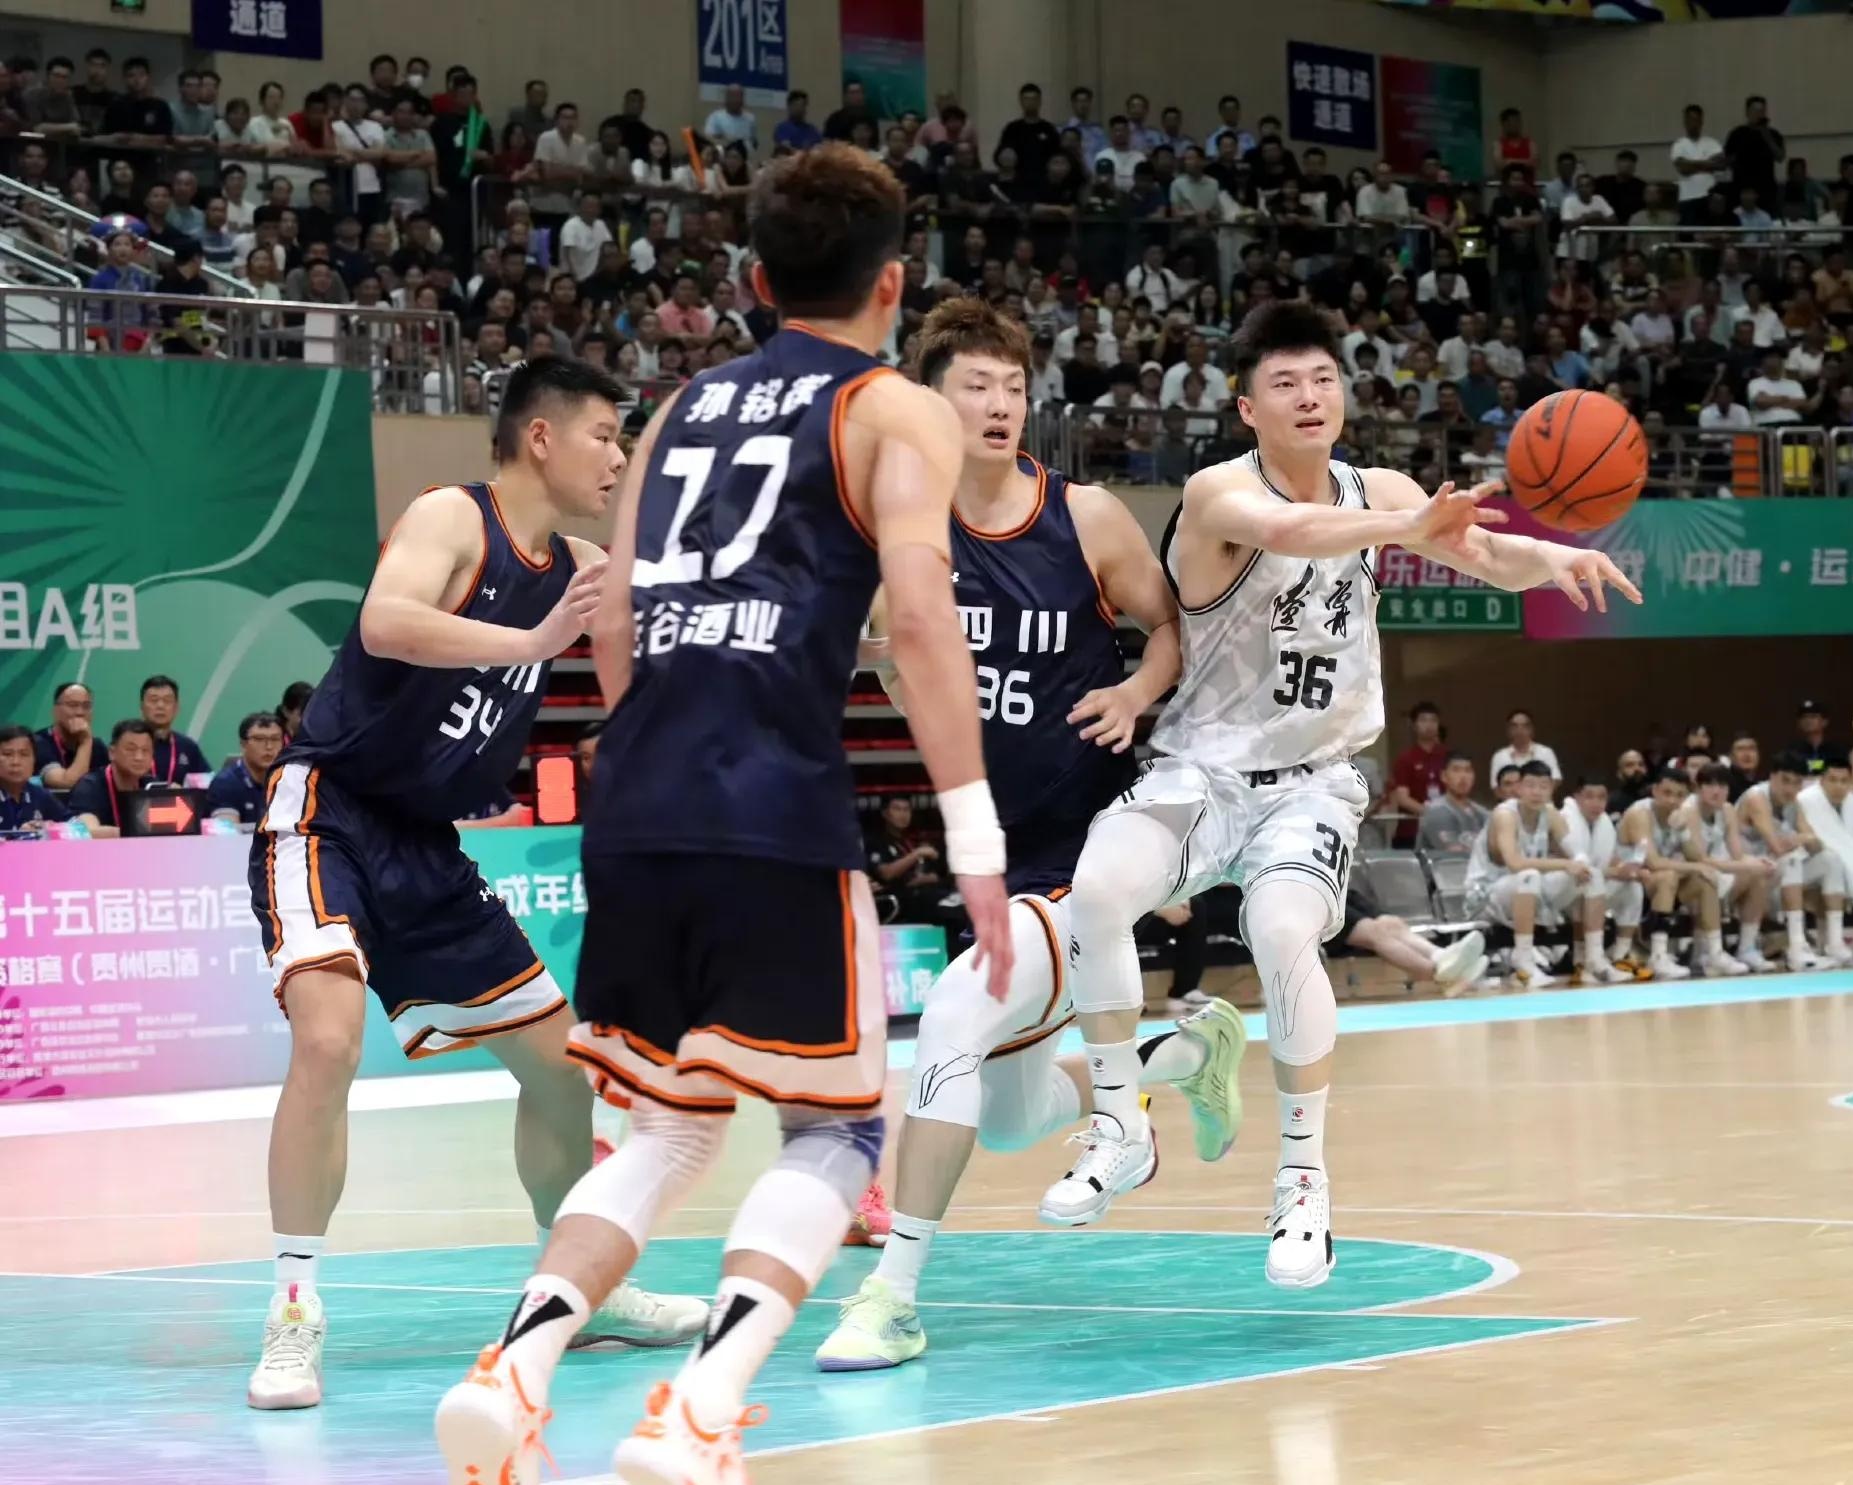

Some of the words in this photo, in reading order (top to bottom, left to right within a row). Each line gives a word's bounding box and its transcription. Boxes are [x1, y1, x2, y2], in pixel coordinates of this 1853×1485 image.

[631, 434, 792, 588] 17
[955, 606, 1068, 653] 四川
[976, 665, 1034, 726] 36
[1273, 651, 1337, 710] 36
[0, 886, 261, 939] 十五届运动会
